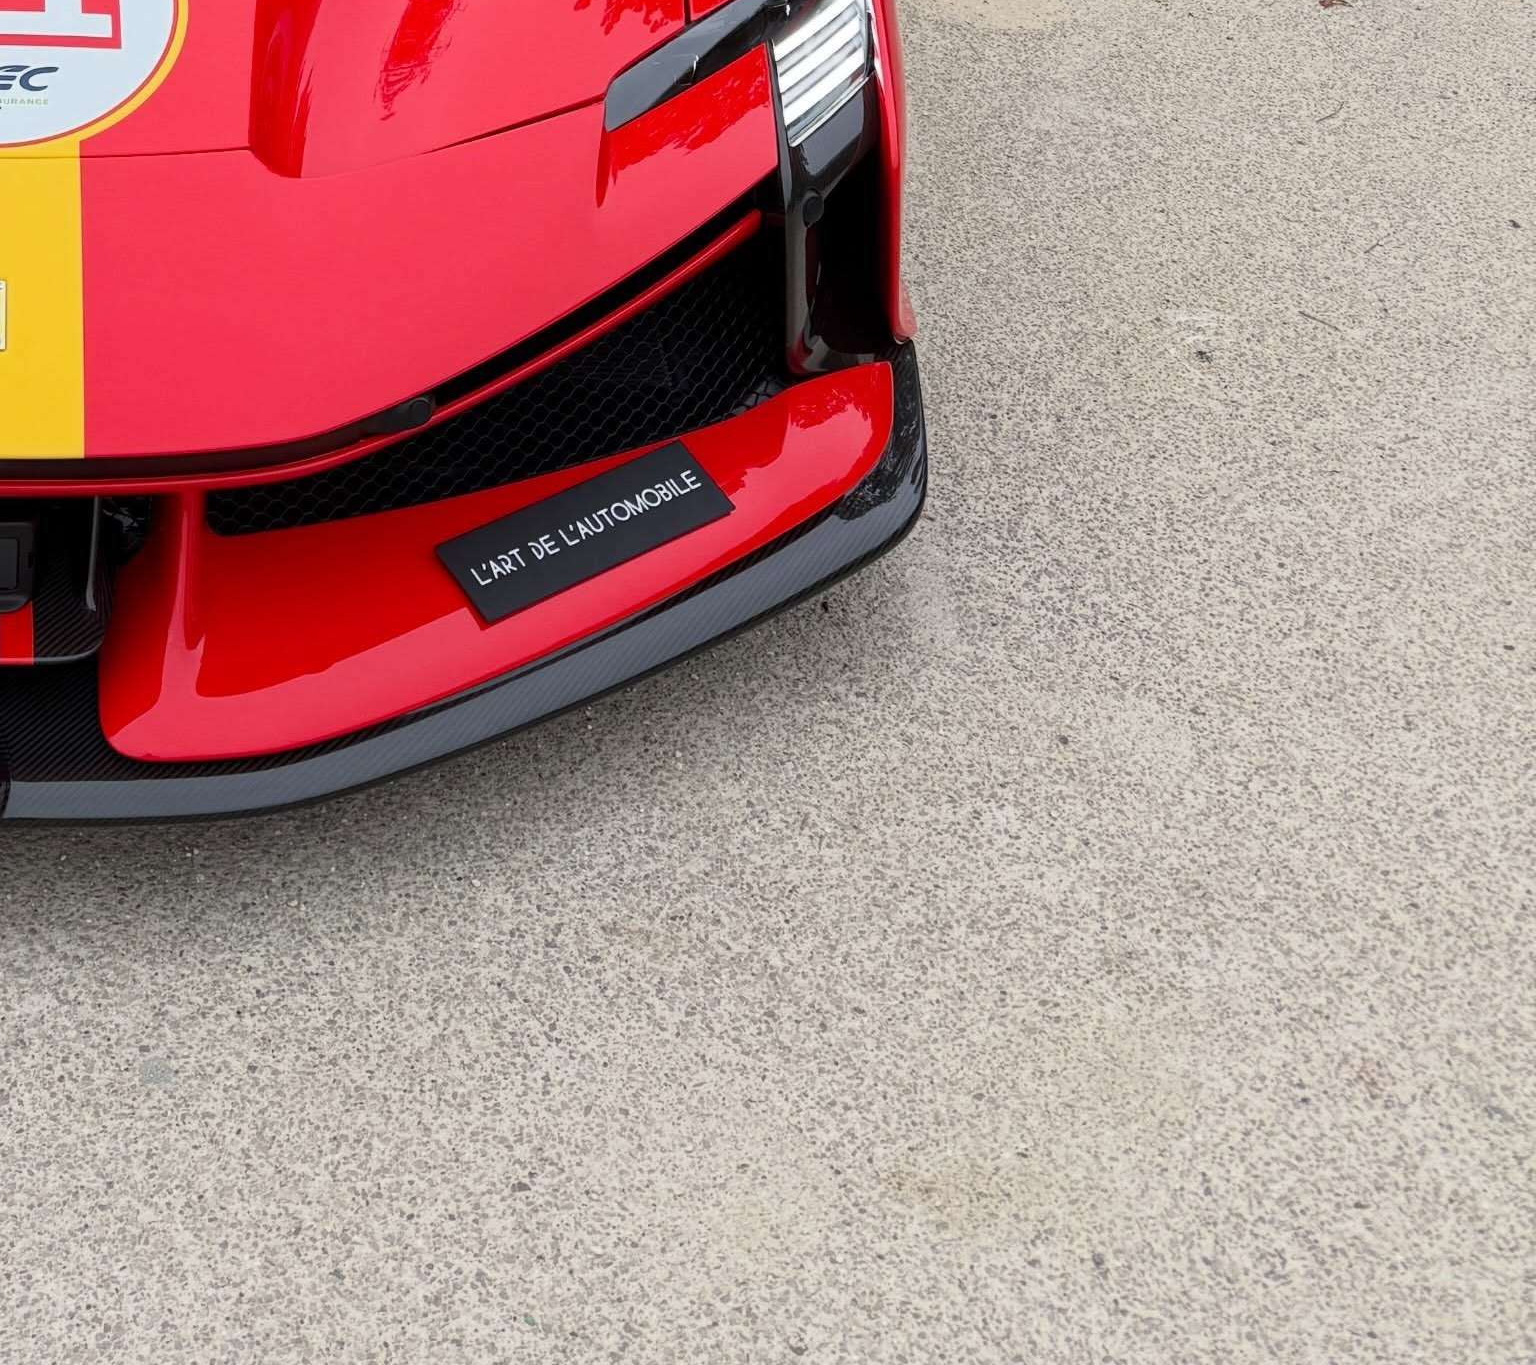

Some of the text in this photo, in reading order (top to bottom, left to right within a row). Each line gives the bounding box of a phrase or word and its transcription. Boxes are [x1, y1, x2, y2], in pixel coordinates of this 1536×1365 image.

[470, 468, 703, 586] L'ART DE L'AUTOMOBILE
